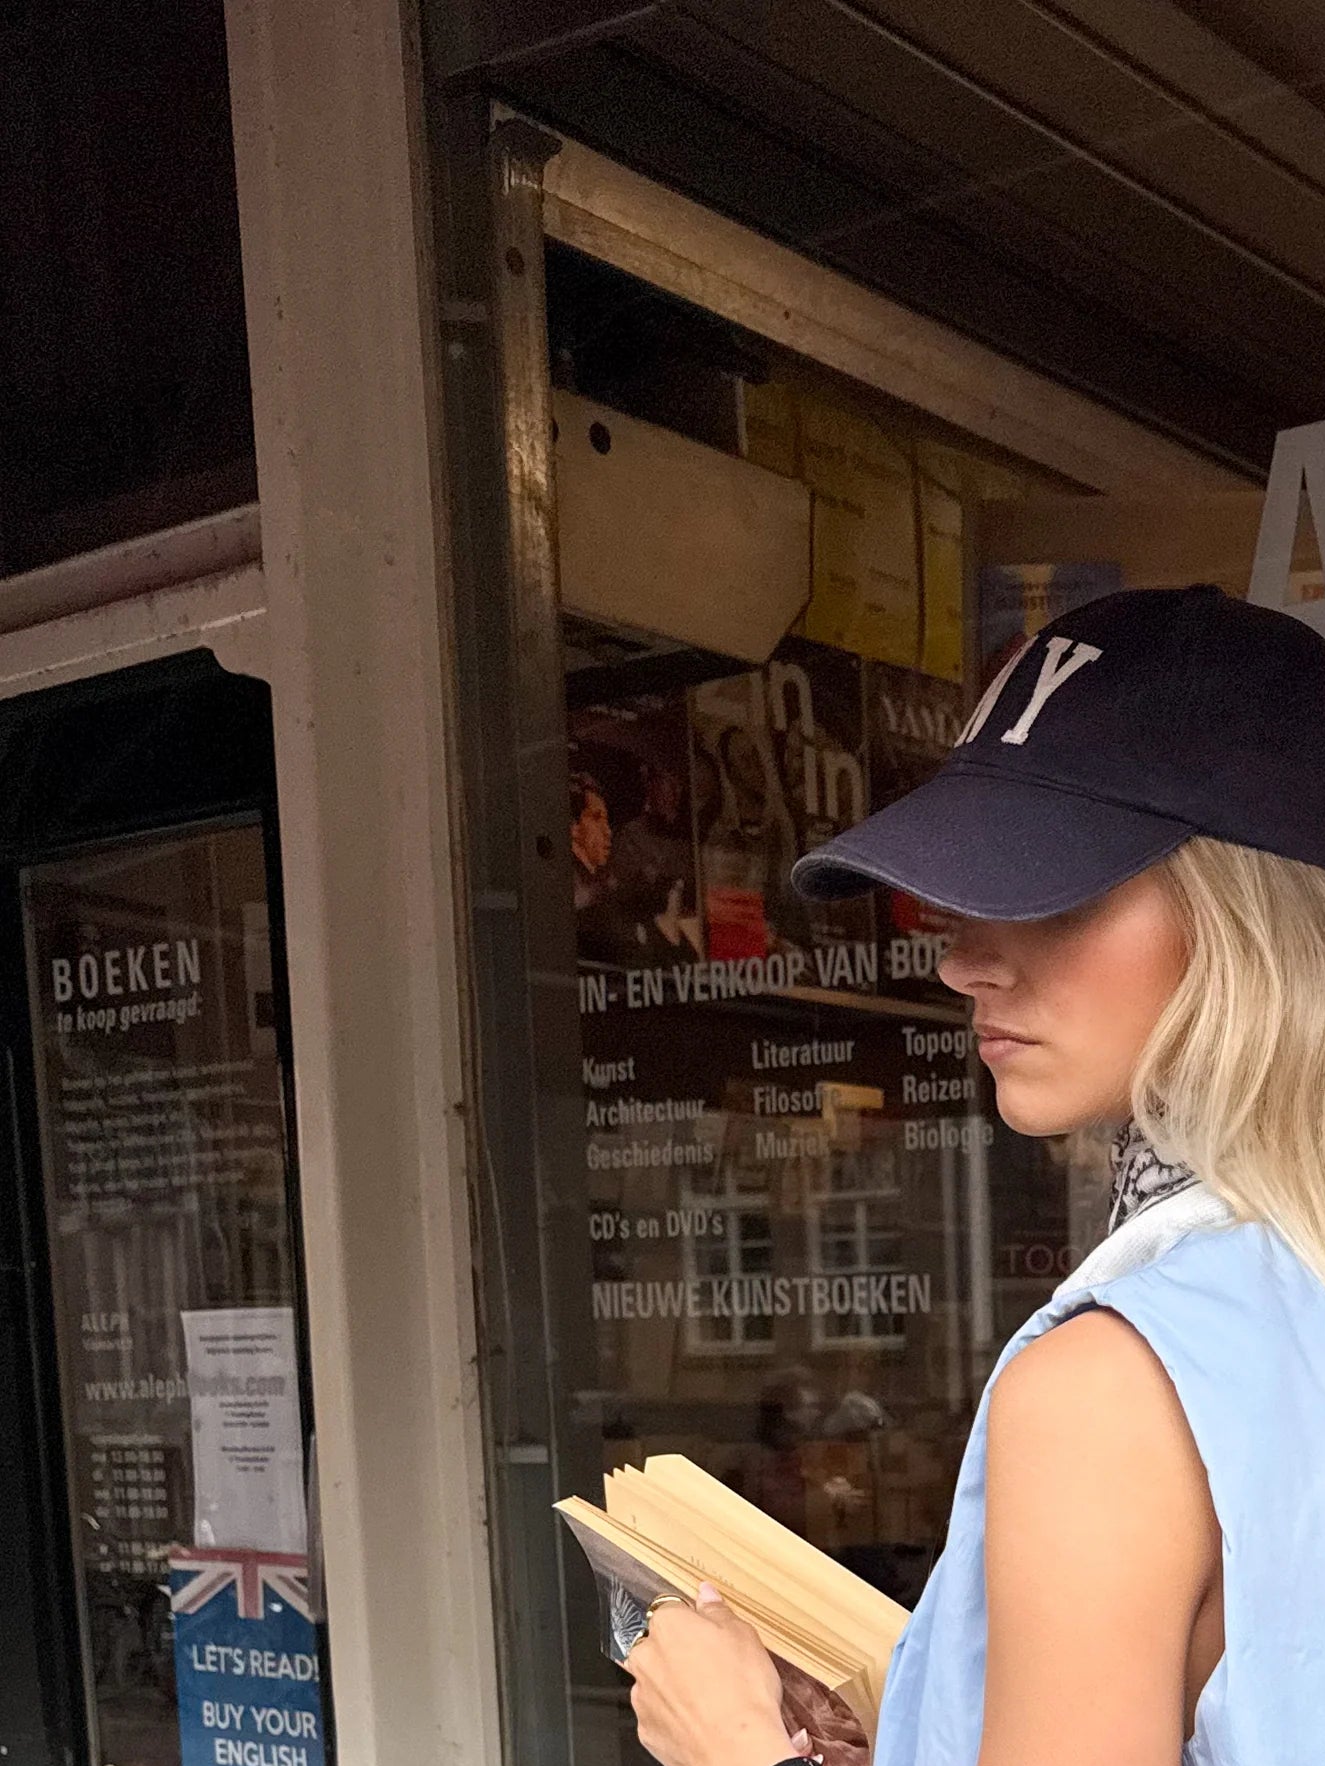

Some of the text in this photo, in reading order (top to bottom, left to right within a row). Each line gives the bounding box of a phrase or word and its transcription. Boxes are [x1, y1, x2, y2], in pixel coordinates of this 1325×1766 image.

[52, 937, 201, 1003] BOEKEN
[579, 975, 618, 1014] IN-
[626, 968, 663, 1009] EN
[674, 953, 802, 1004] VERKOOP
[814, 942, 878, 988] VAN
[75, 1002, 117, 1034] koop
[582, 1056, 636, 1085] Kunst
[752, 1039, 855, 1071] Literatuur
[586, 1098, 705, 1128] Architectuur
[903, 1075, 976, 1105] Reizen
[587, 1119, 995, 1171] Geschiedenis Muziek Biologie
[590, 1208, 724, 1241] CD's en DVD's
[592, 1273, 932, 1321] NIEUWE KUNSTBOEKEN
[192, 1643, 320, 1683] LET'S READ!
[202, 1700, 318, 1741] BUY YOUR
